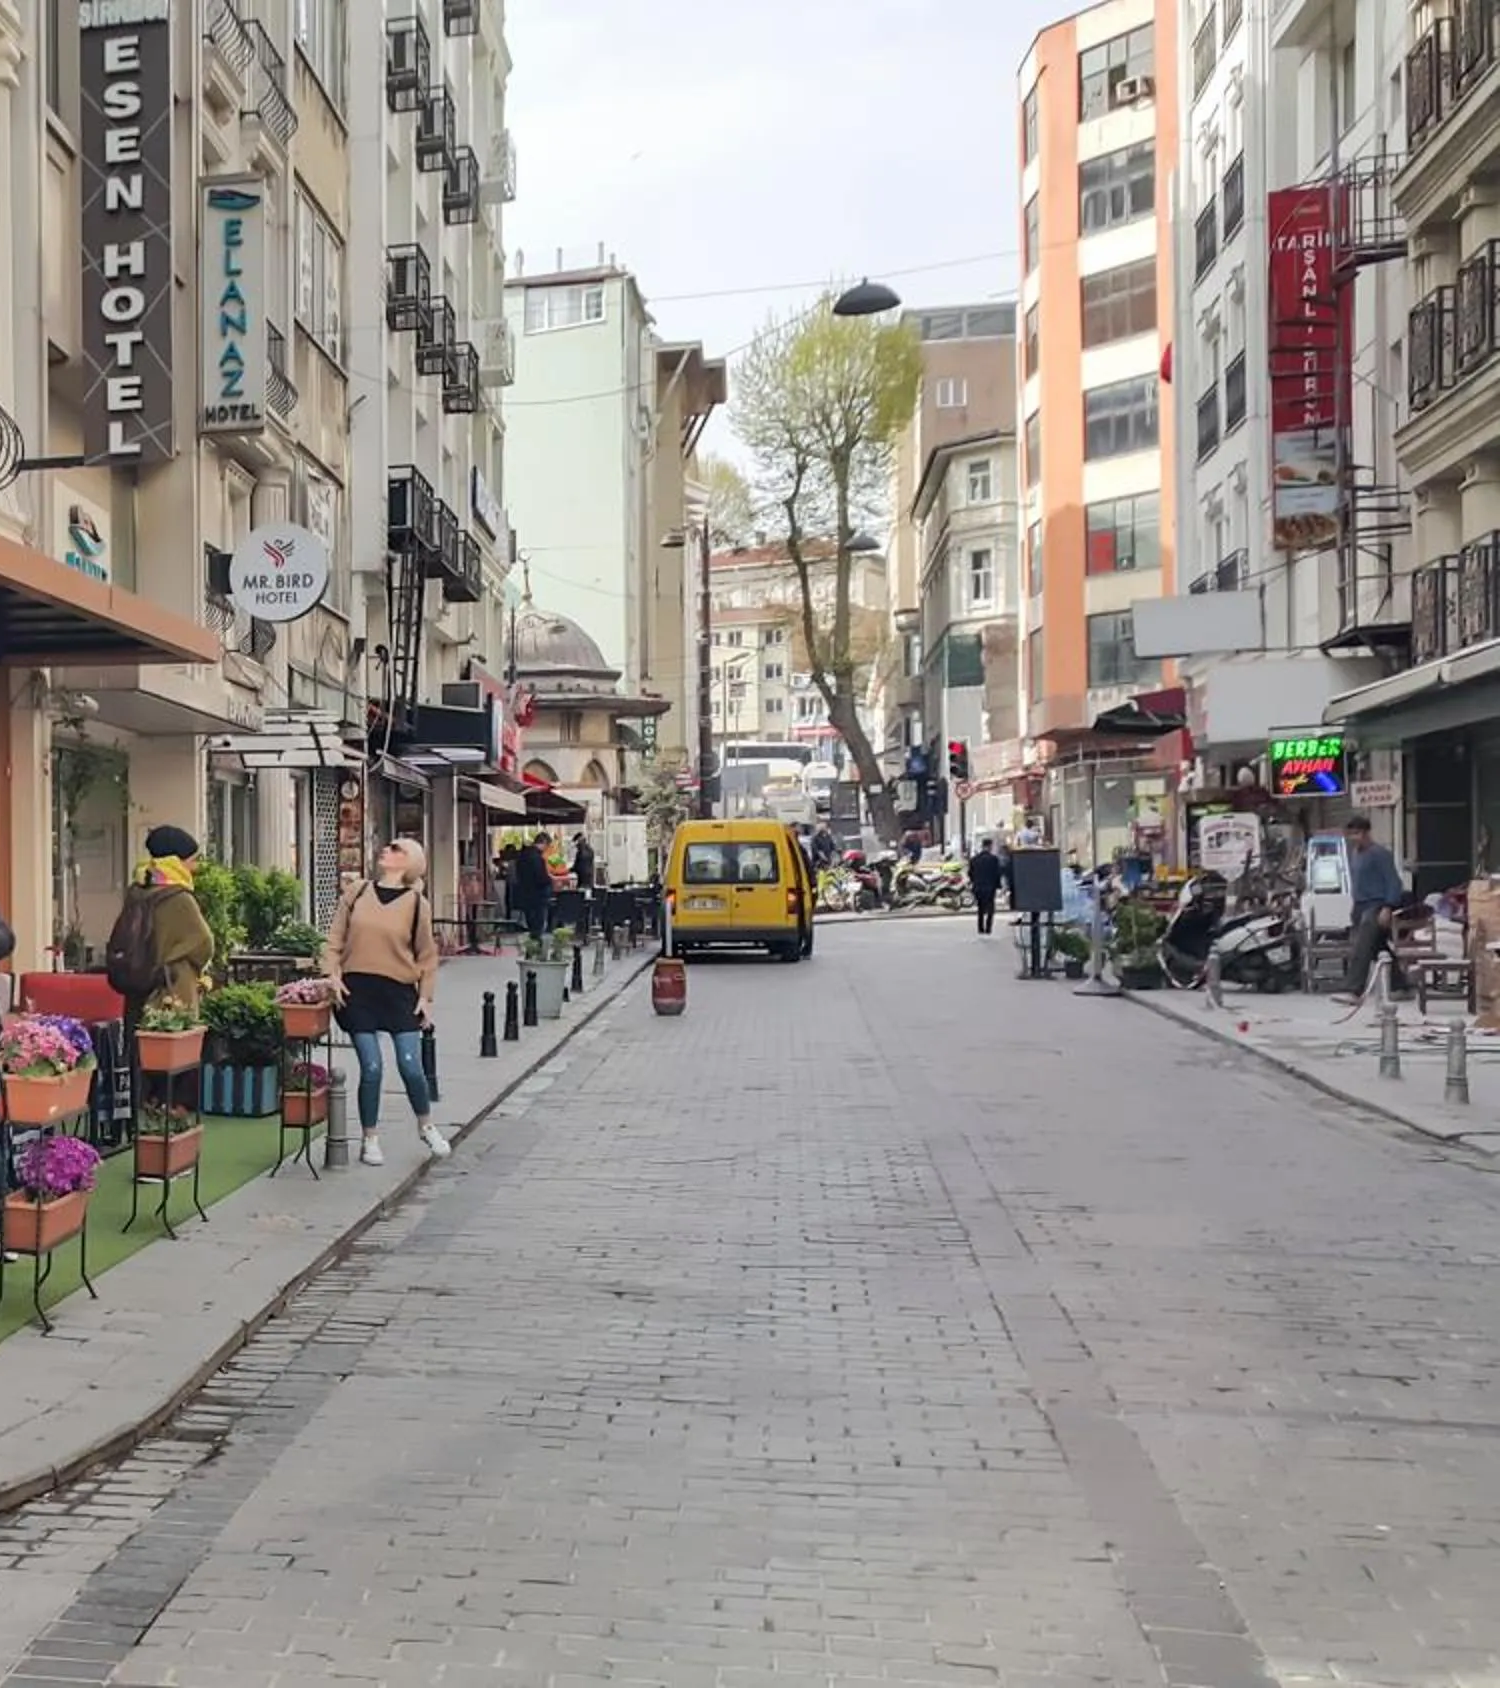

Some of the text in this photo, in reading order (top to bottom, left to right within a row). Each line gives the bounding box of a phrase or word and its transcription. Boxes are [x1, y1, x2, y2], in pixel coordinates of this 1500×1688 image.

[101, 36, 145, 454] ESEN HOTEL
[218, 219, 248, 398] ELANAZ
[205, 403, 260, 425] HOTEL
[243, 573, 314, 589] MR. BIRD
[256, 592, 297, 604] HOTEL
[1274, 738, 1341, 759] BERBER
